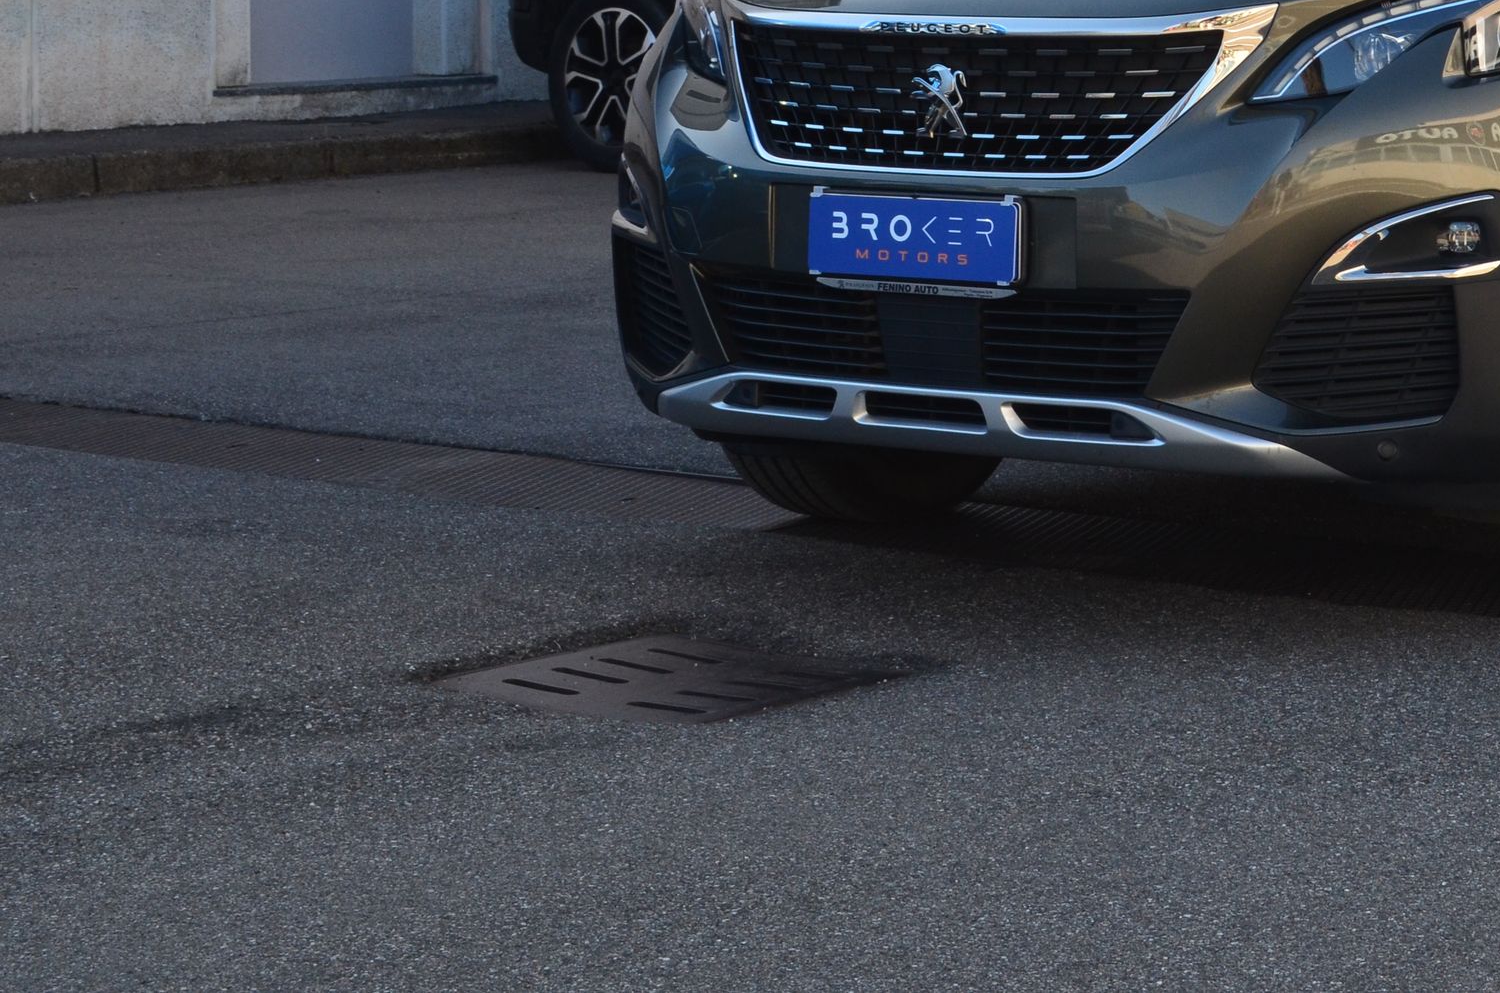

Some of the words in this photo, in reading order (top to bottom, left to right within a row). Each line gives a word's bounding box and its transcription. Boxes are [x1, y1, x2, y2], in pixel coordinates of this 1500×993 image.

[879, 22, 989, 35] PEUGEOT
[831, 210, 995, 247] BROKER
[855, 248, 969, 266] MOTORS
[877, 282, 912, 293] FENINO
[914, 284, 939, 295] AUTO
